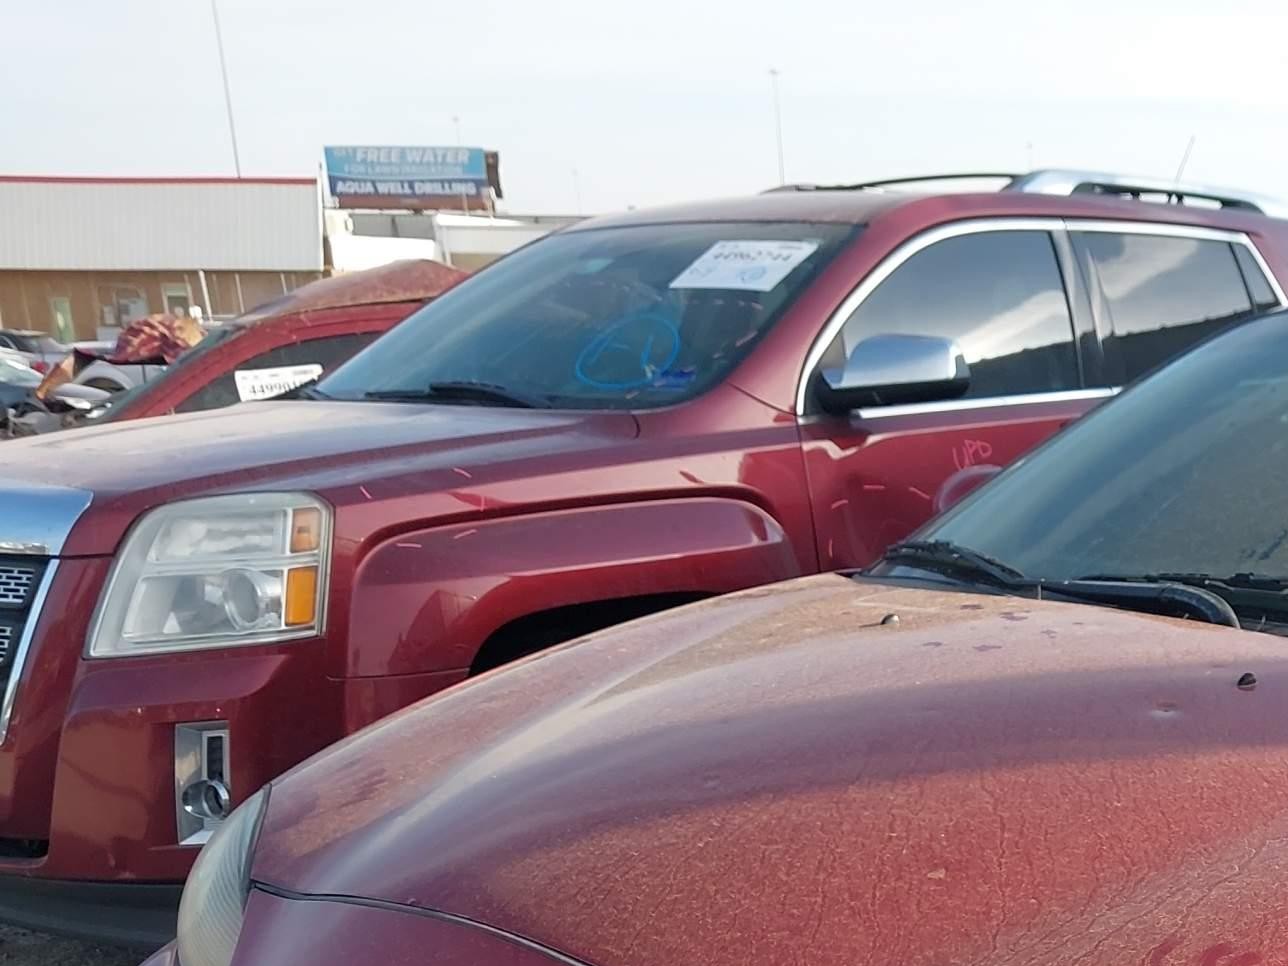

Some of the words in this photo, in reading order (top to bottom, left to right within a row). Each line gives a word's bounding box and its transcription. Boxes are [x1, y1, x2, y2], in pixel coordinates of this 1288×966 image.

[356, 148, 401, 163] FREE
[406, 148, 469, 164] WATER
[336, 180, 375, 194] AQUA
[376, 181, 412, 195] WELL
[414, 181, 476, 195] DRILLING
